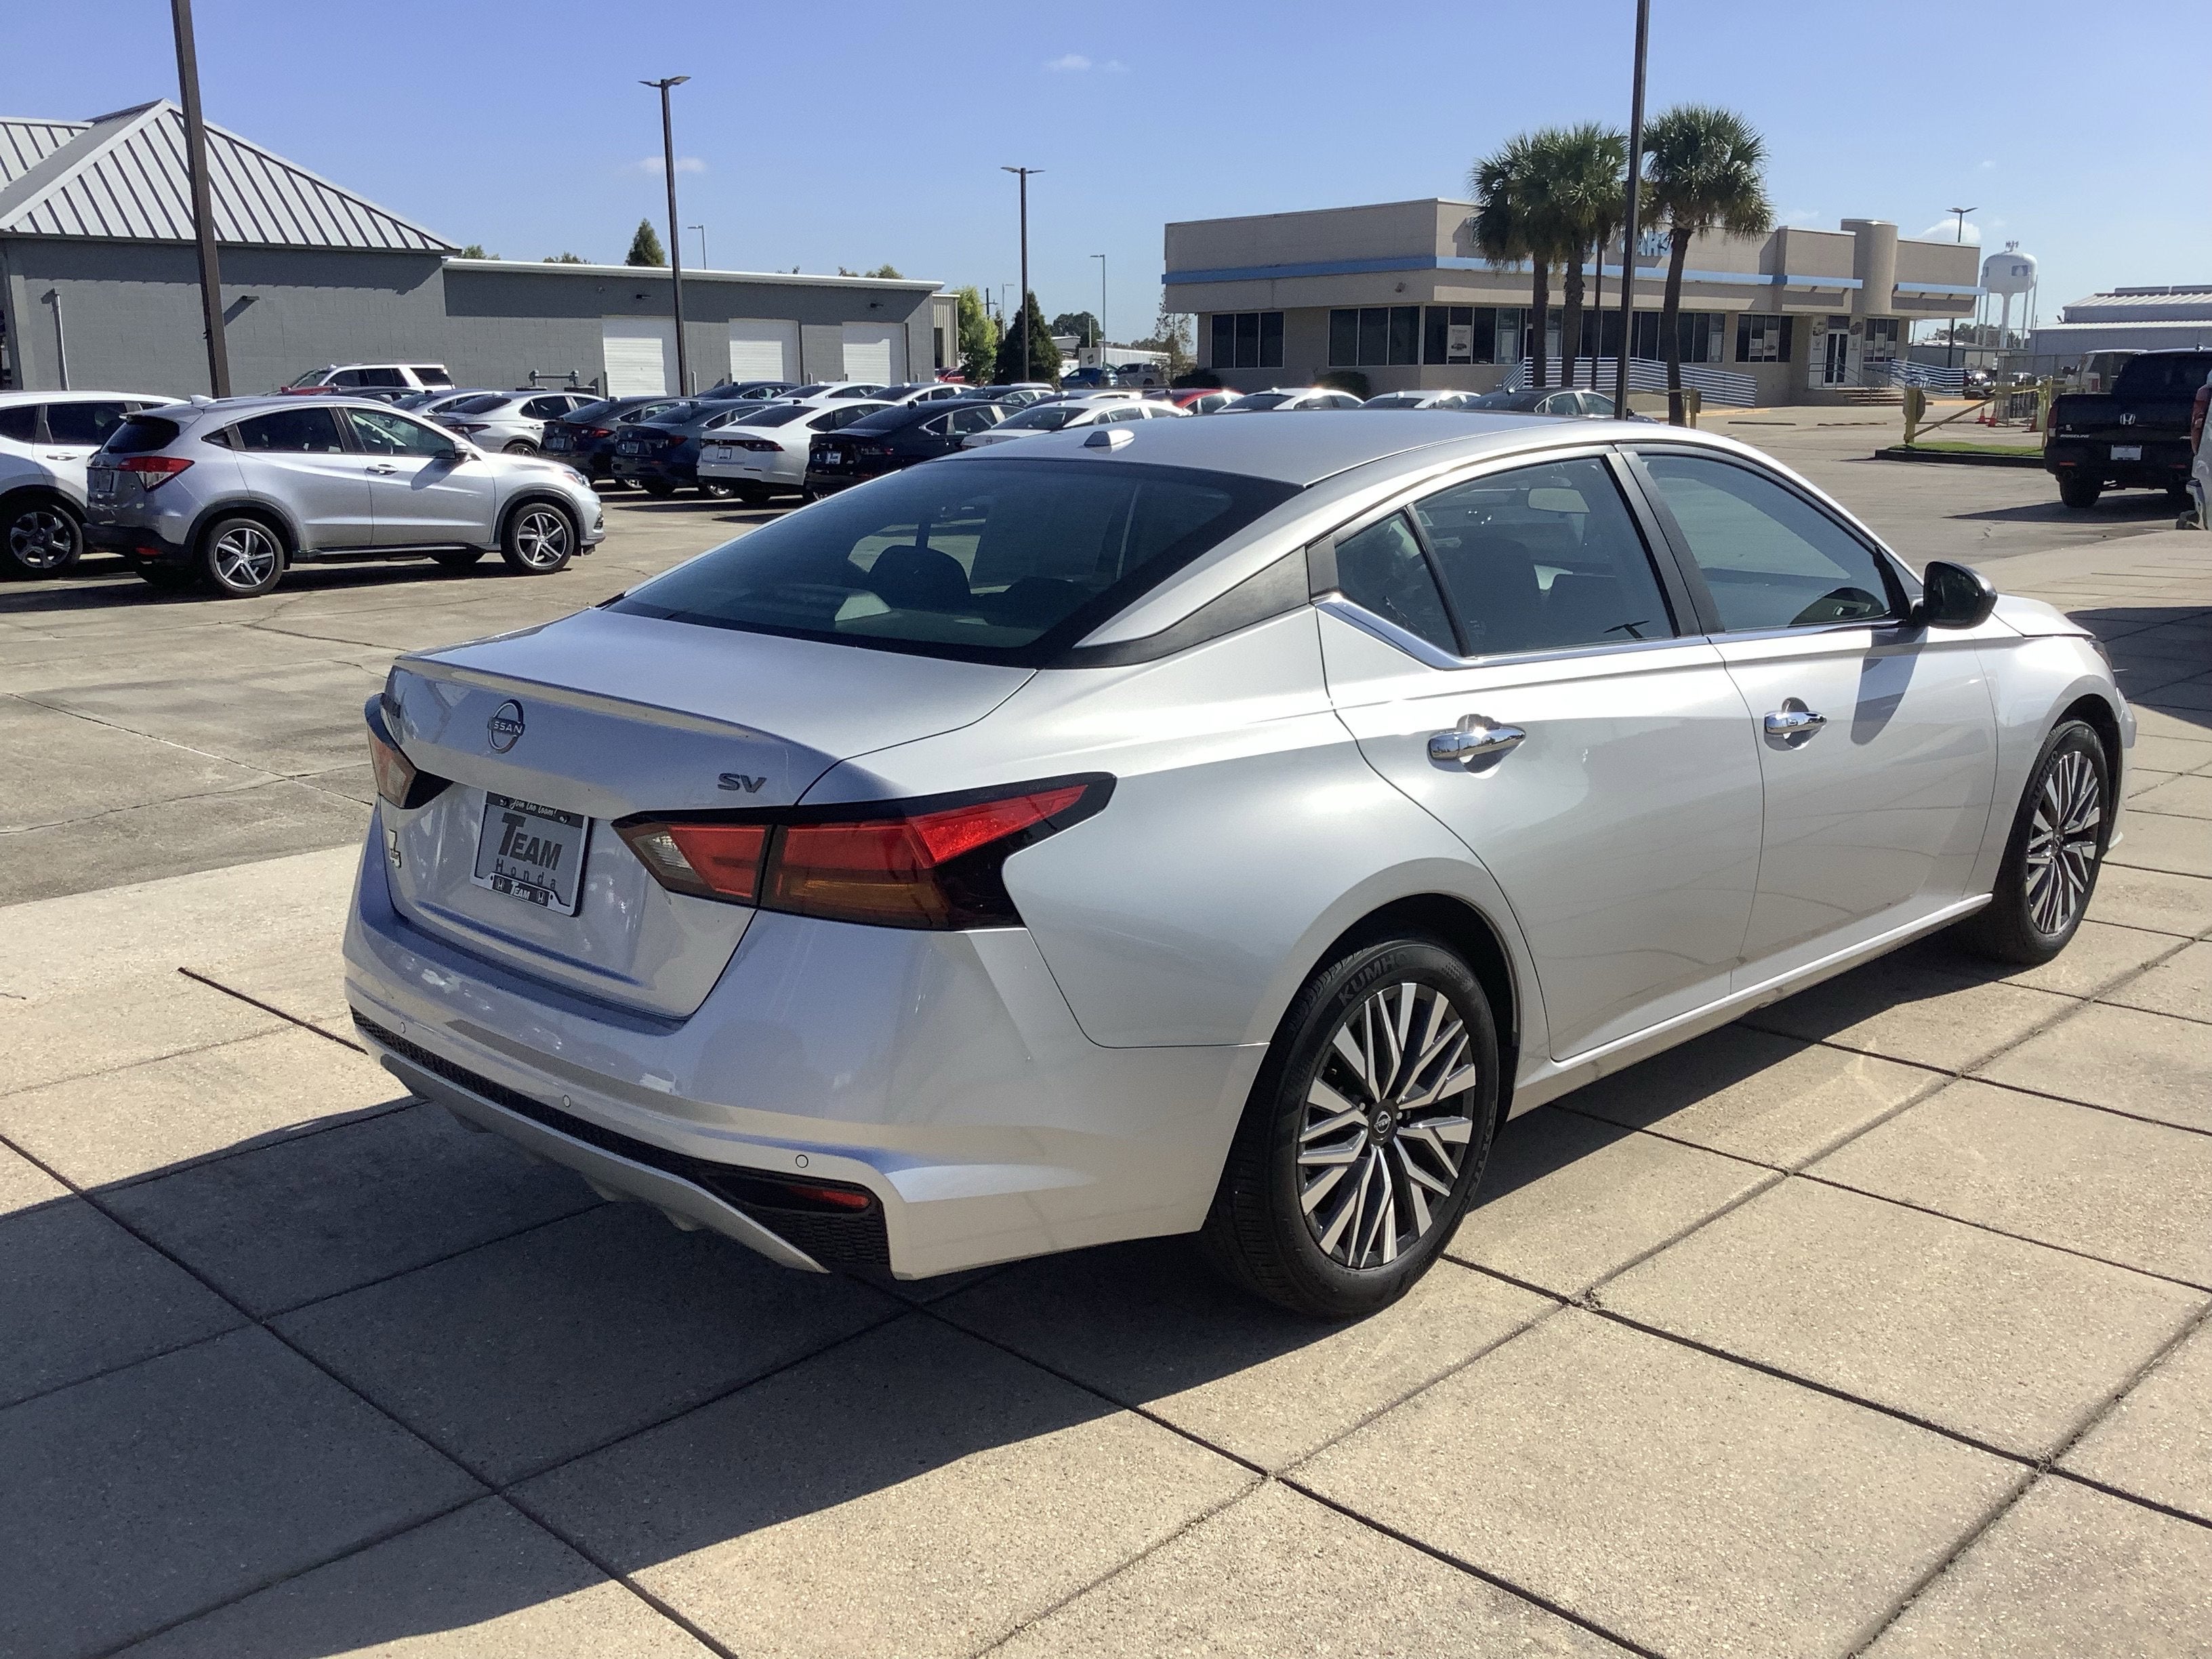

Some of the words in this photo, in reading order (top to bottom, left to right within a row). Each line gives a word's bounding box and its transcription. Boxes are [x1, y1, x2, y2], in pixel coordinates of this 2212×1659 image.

[717, 773, 767, 794] SV
[498, 813, 562, 870] TEAM
[495, 858, 556, 890] Honda
[510, 882, 531, 901] TEAM
[1338, 951, 1406, 1006] KUMHO
